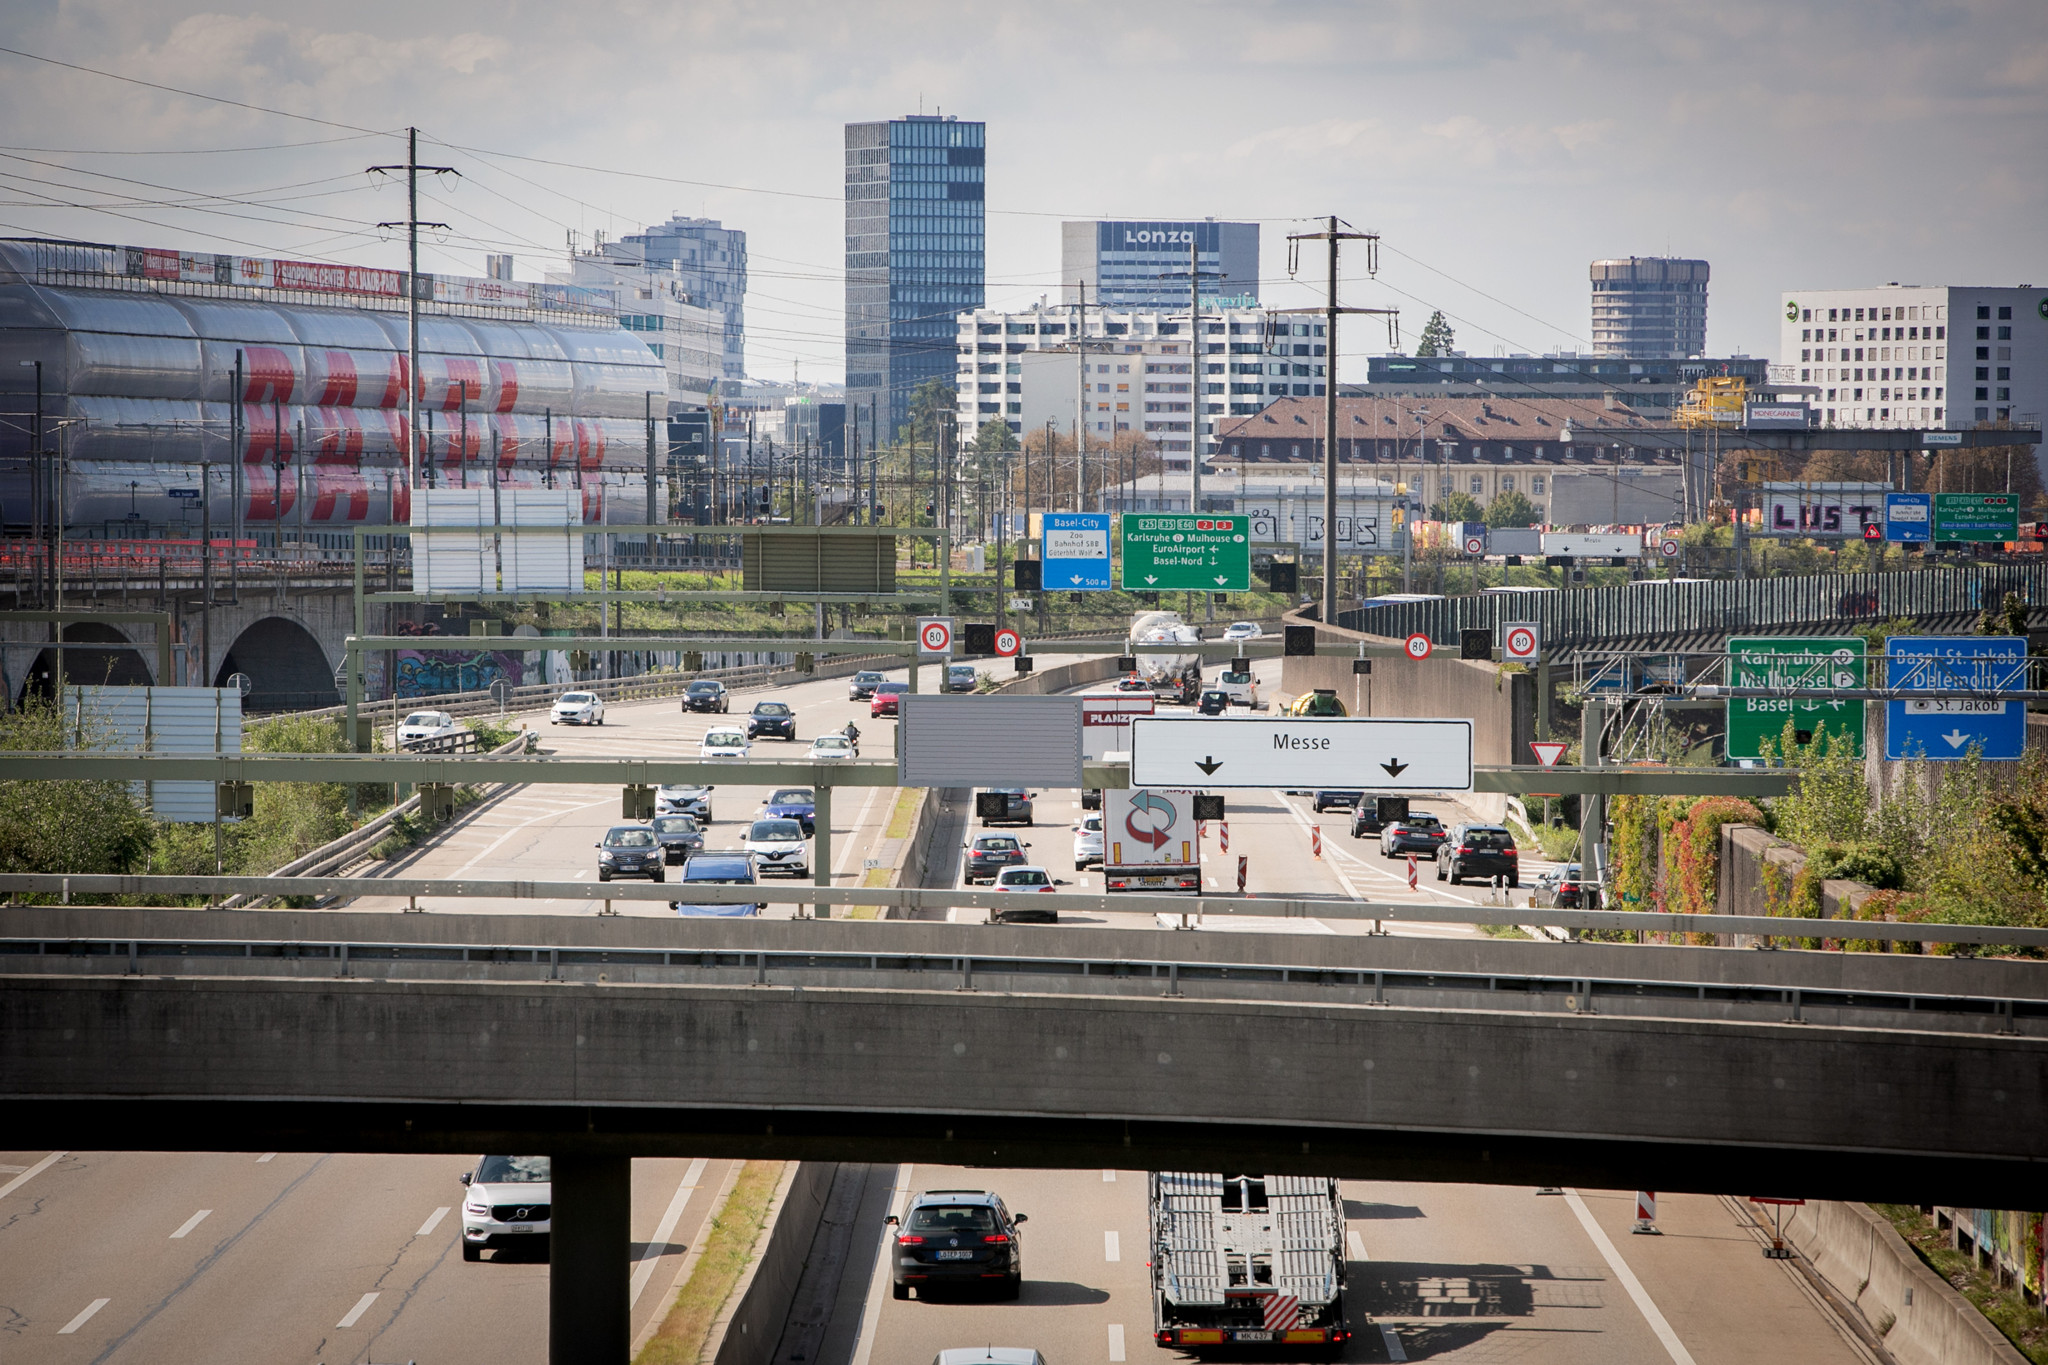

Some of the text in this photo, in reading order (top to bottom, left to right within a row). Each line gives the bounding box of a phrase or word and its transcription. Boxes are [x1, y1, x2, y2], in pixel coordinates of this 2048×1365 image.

[1126, 230, 1194, 244] Lonza
[241, 258, 264, 283] coop
[281, 265, 318, 287] SHOPPING
[320, 268, 345, 288] CENTER
[1054, 518, 1099, 529] Basel-City
[1774, 504, 1878, 532] LUST
[1127, 533, 1170, 542] Karlsruhe
[1187, 533, 1231, 542] Mulhouse
[1153, 544, 1205, 555] EuroAirport
[1153, 556, 1203, 566] Basel-Nord
[1086, 578, 1099, 586] 500
[929, 632, 941, 642] 80
[1000, 637, 1013, 648] 80
[1515, 637, 1528, 647] 80
[1412, 642, 1425, 652] 80
[1741, 647, 1849, 665] Karlsruhe D
[1971, 648, 2018, 665] Jakob
[1740, 670, 1847, 688] Mulhouse F
[1747, 697, 1793, 712] Basel
[1936, 699, 2000, 712] St. Jakob
[1090, 714, 1131, 724] PLANZ
[1273, 734, 1331, 750] Messe
[1241, 1331, 1268, 1340] MK 437
